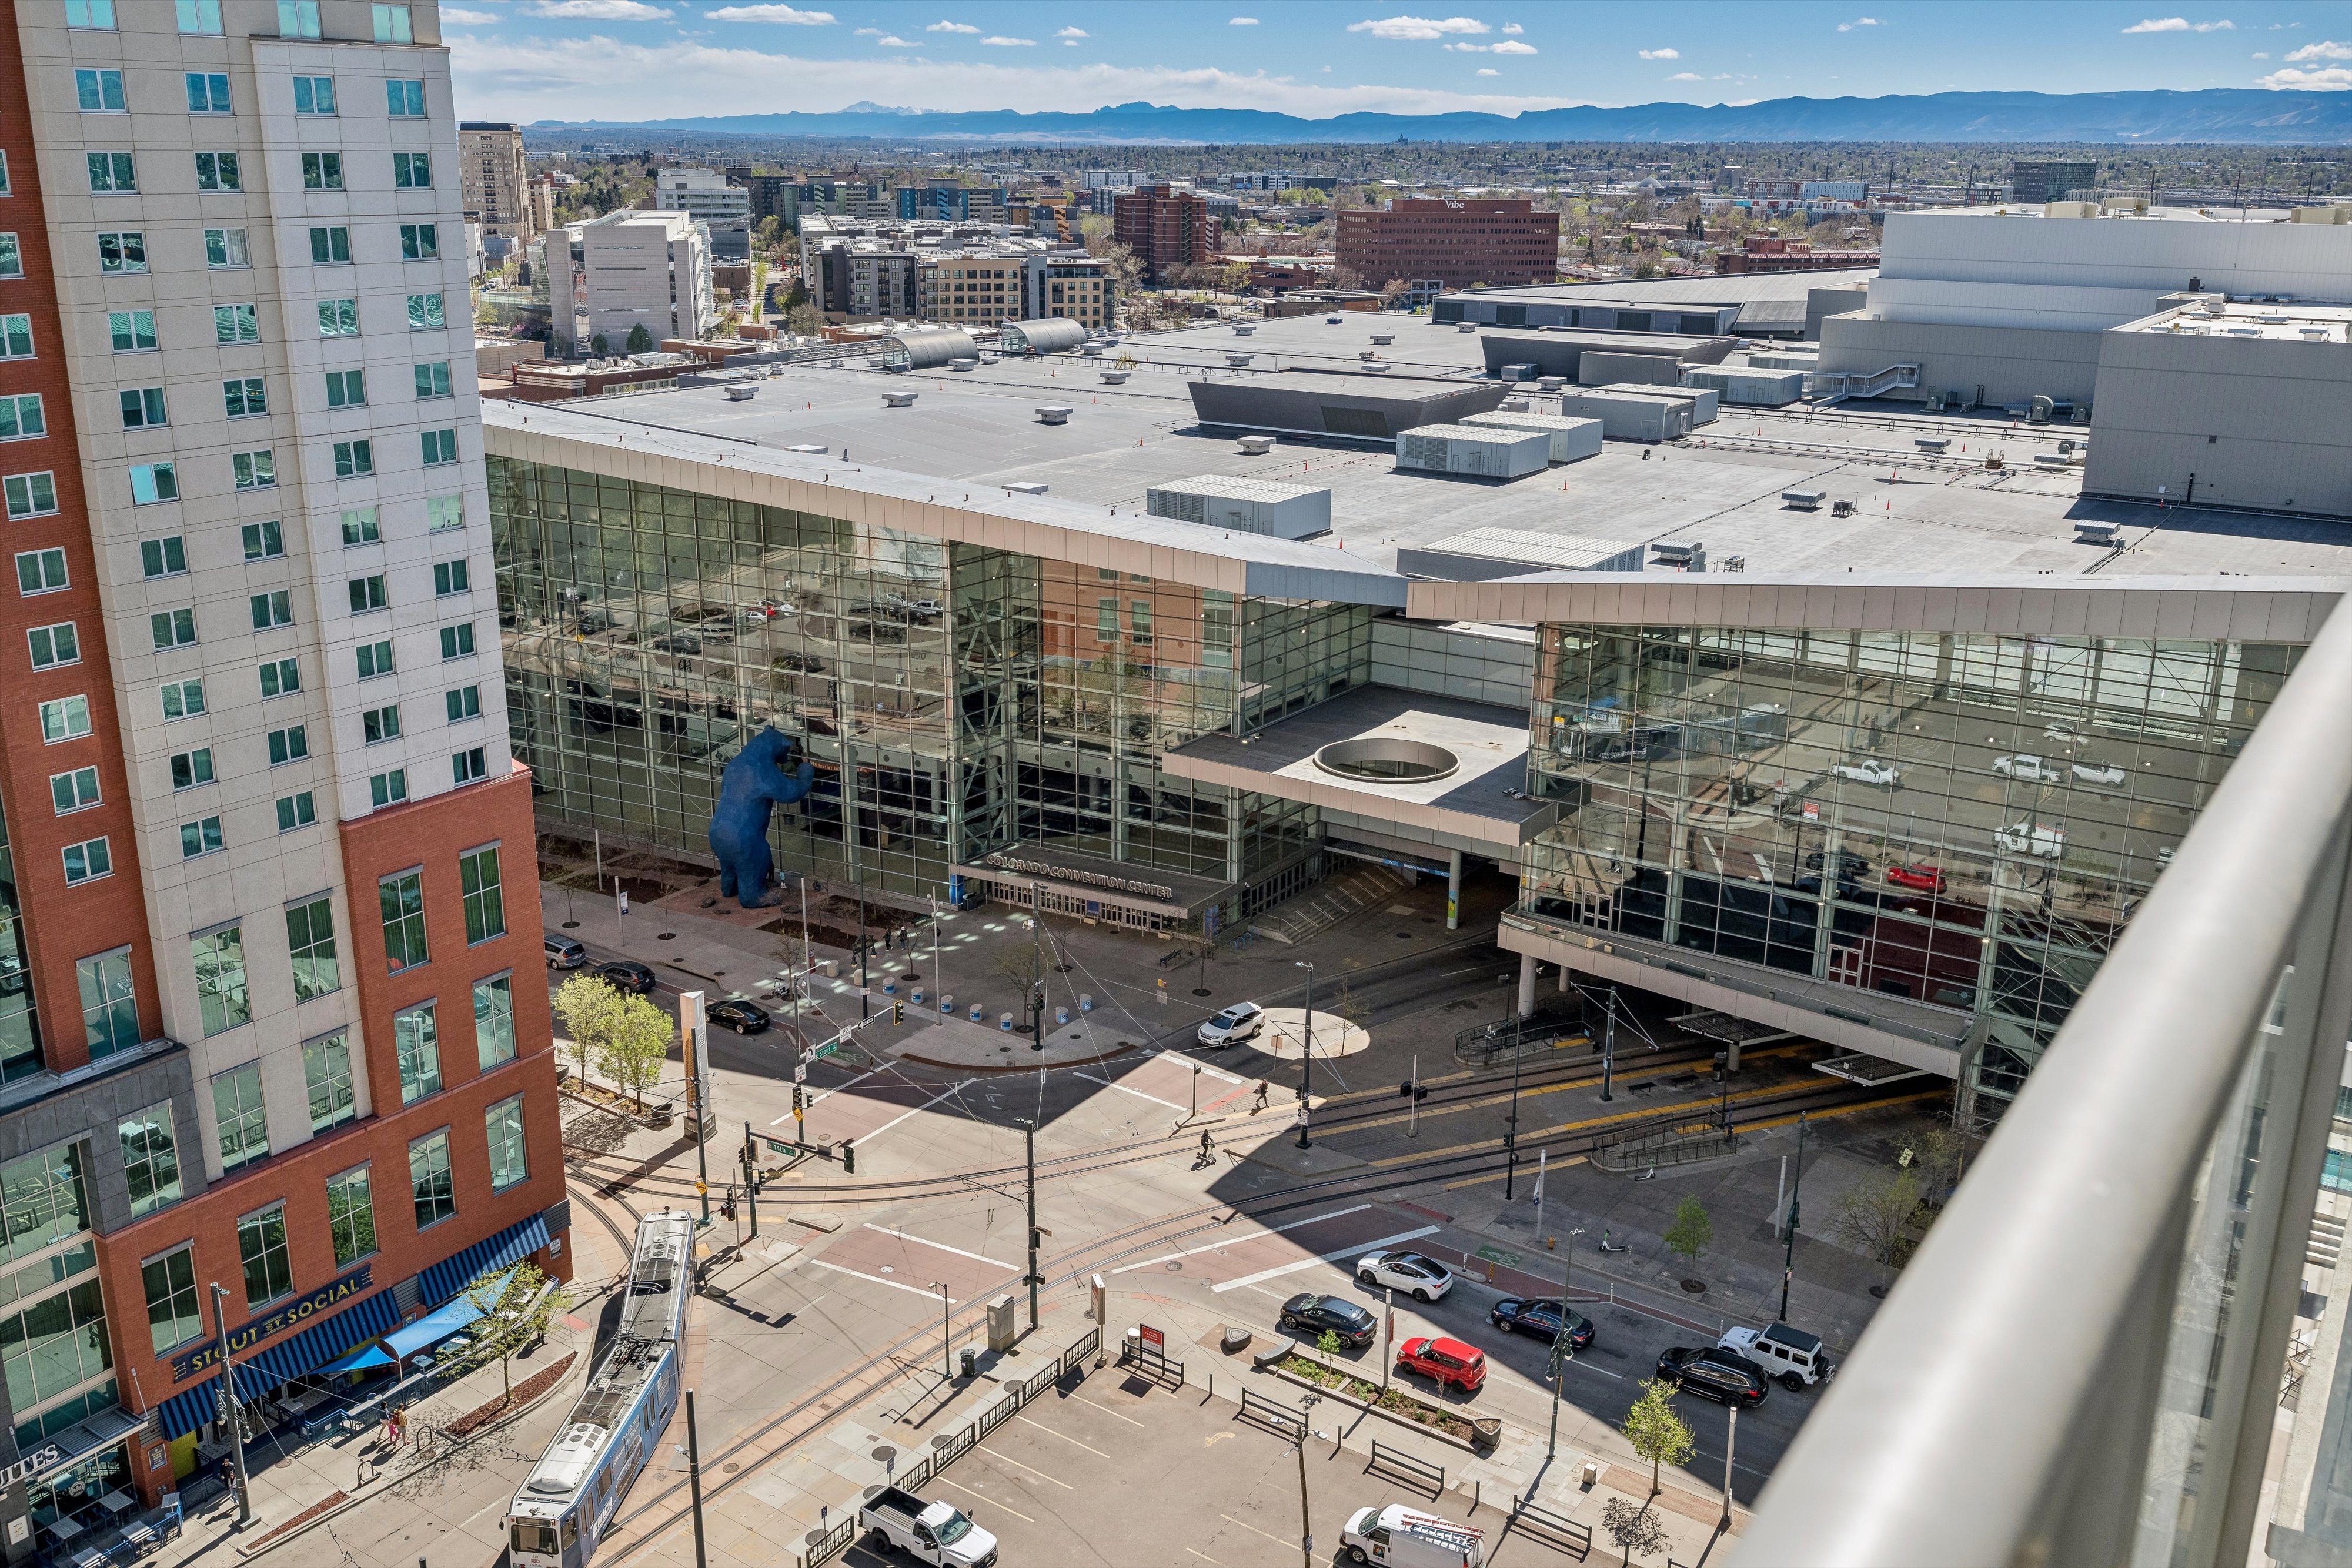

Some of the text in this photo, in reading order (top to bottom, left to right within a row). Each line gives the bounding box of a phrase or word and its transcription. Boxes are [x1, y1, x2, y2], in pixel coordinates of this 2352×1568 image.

[987, 854, 1172, 898] COLORADO CONVENTION CENTER
[1704, 1032, 1722, 1041] Convention
[820, 1047, 831, 1057] Stout
[774, 1145, 786, 1153] 14th
[192, 1326, 258, 1370] STOUT
[287, 1279, 359, 1323] SOCIAL
